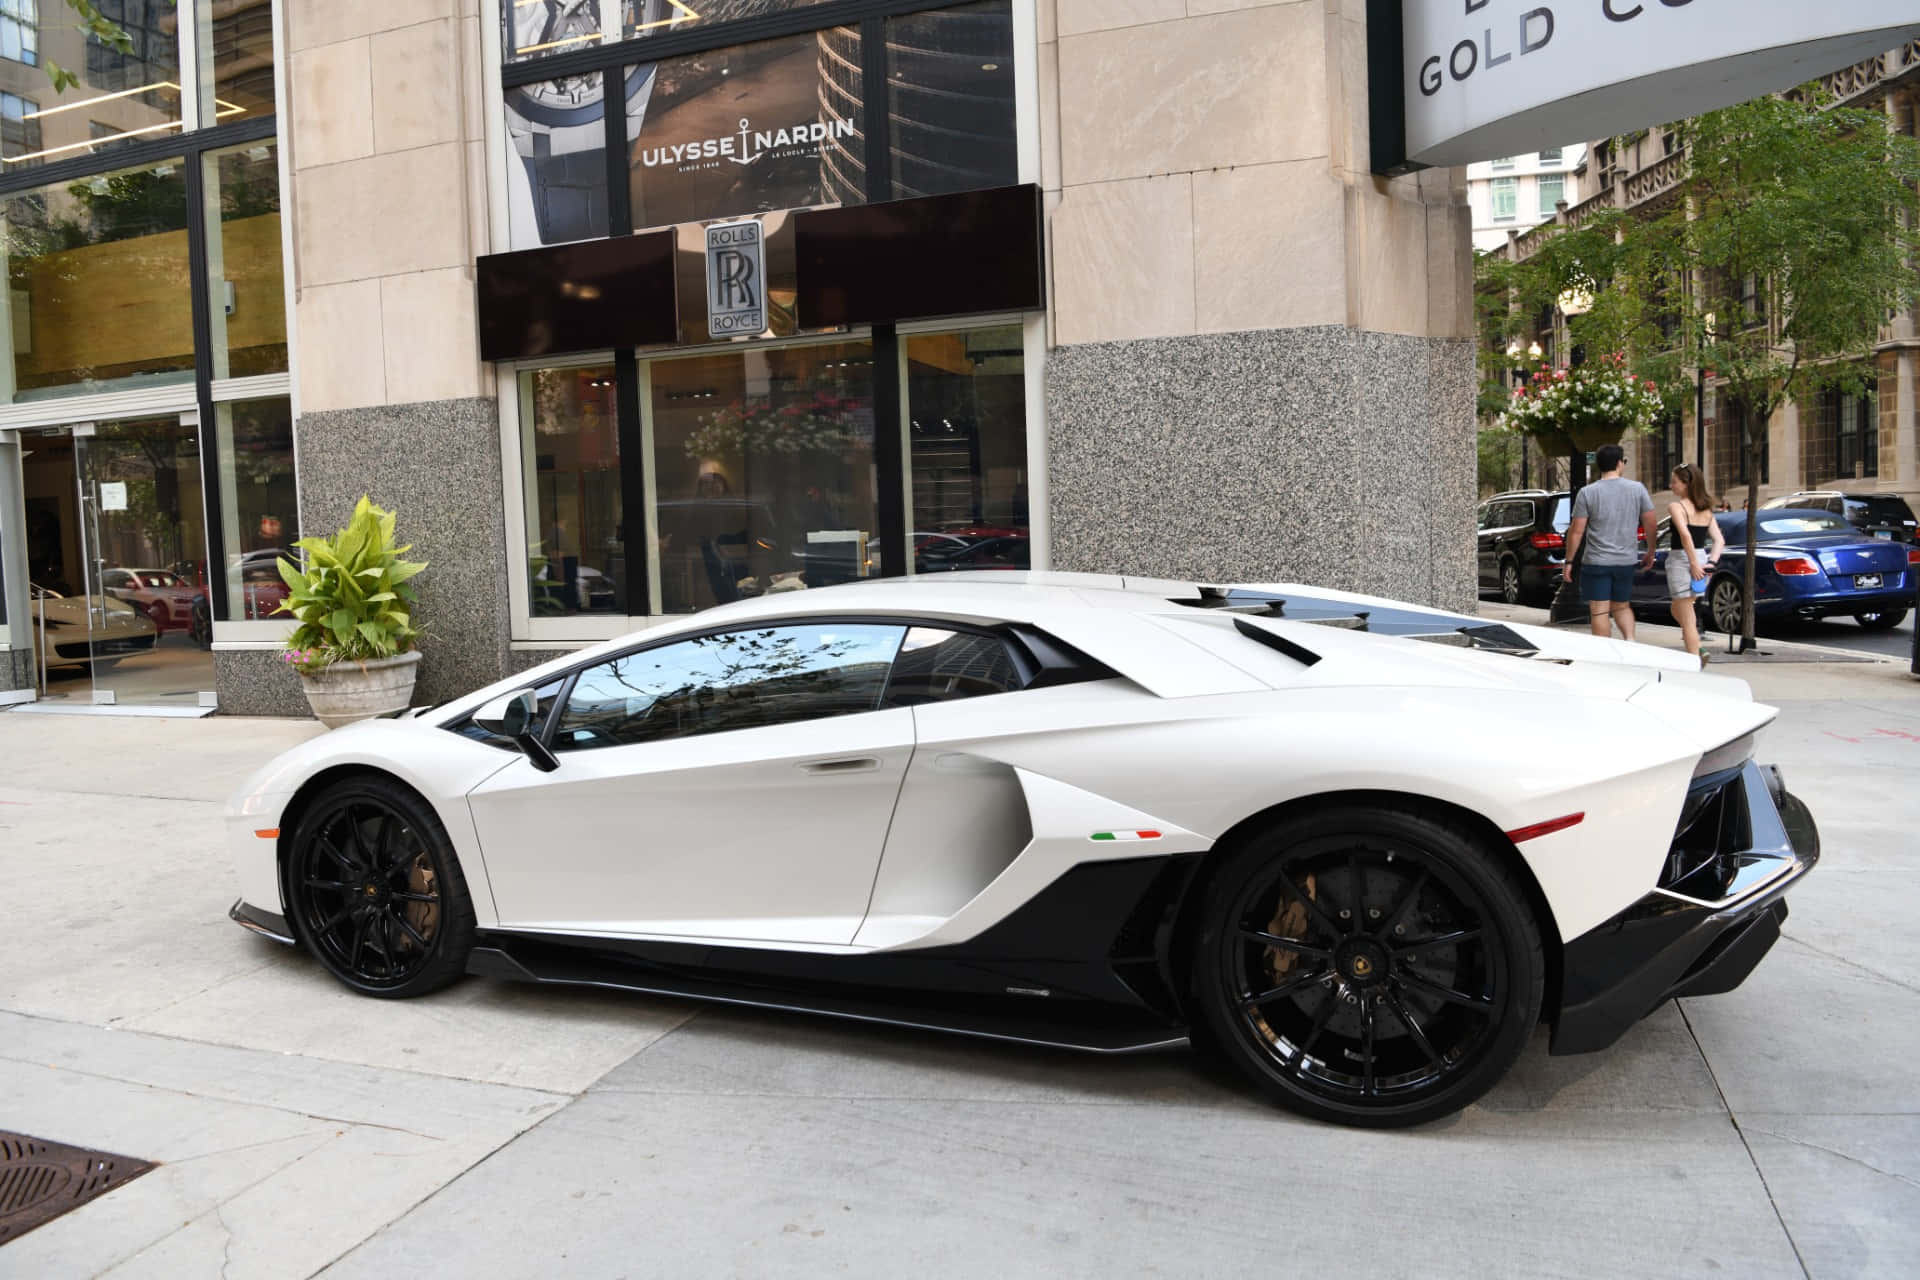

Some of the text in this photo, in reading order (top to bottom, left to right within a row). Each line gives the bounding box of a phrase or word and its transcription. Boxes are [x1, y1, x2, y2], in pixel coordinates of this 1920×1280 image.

[1419, 6, 1554, 97] GOLD
[642, 118, 854, 167] ULYSSE NARDIN
[711, 228, 756, 246] ROLLS
[713, 313, 760, 330] ROYCE
